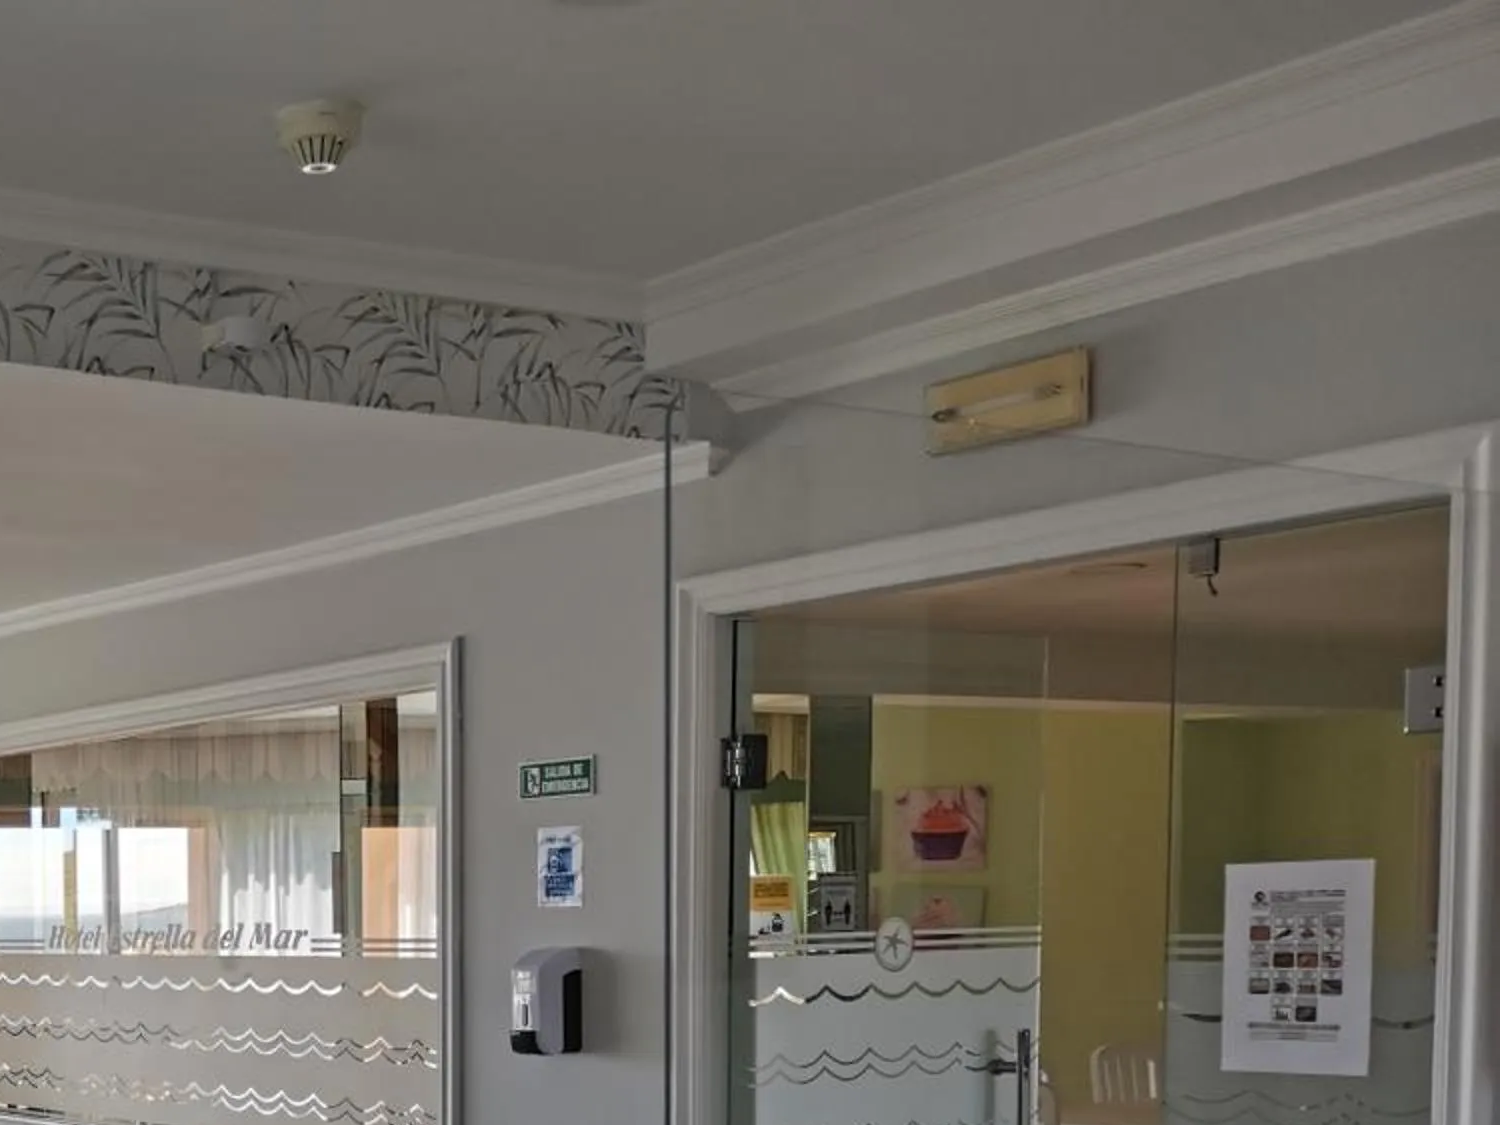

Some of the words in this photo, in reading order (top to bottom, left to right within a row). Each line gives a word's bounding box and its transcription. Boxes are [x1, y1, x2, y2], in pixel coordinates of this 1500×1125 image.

[49, 925, 102, 949] Hotel
[108, 924, 196, 951] strella
[203, 922, 243, 949] del
[249, 922, 308, 949] Mar
